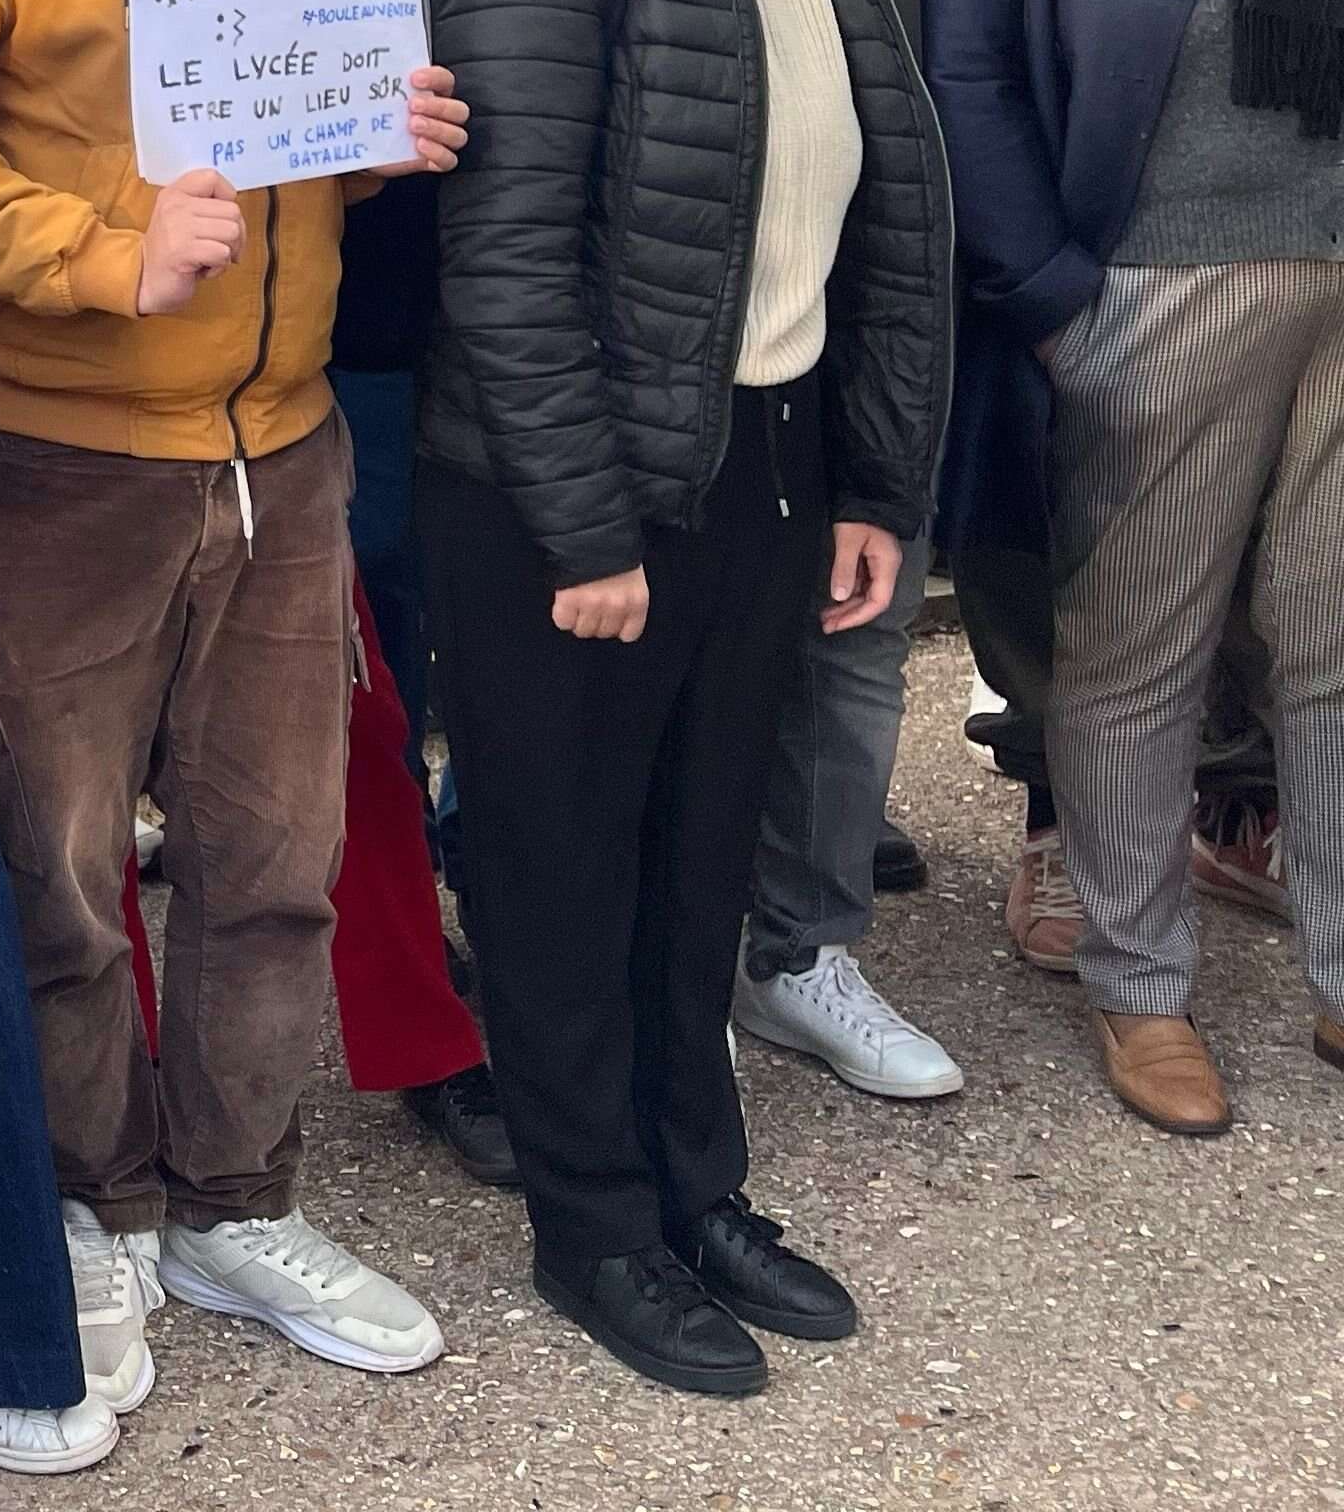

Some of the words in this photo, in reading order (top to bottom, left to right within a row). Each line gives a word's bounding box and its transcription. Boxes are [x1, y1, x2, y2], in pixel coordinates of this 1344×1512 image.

[159, 59, 203, 89] LE
[233, 40, 318, 81] LYCÉE
[342, 47, 391, 73] DOIT
[170, 100, 233, 123] ETRE
[253, 96, 282, 120] UN
[305, 85, 351, 114] LIEU
[212, 139, 245, 167] PAS
[268, 129, 291, 151] UN
[304, 117, 358, 144] CHAMP
[371, 112, 394, 132] DE
